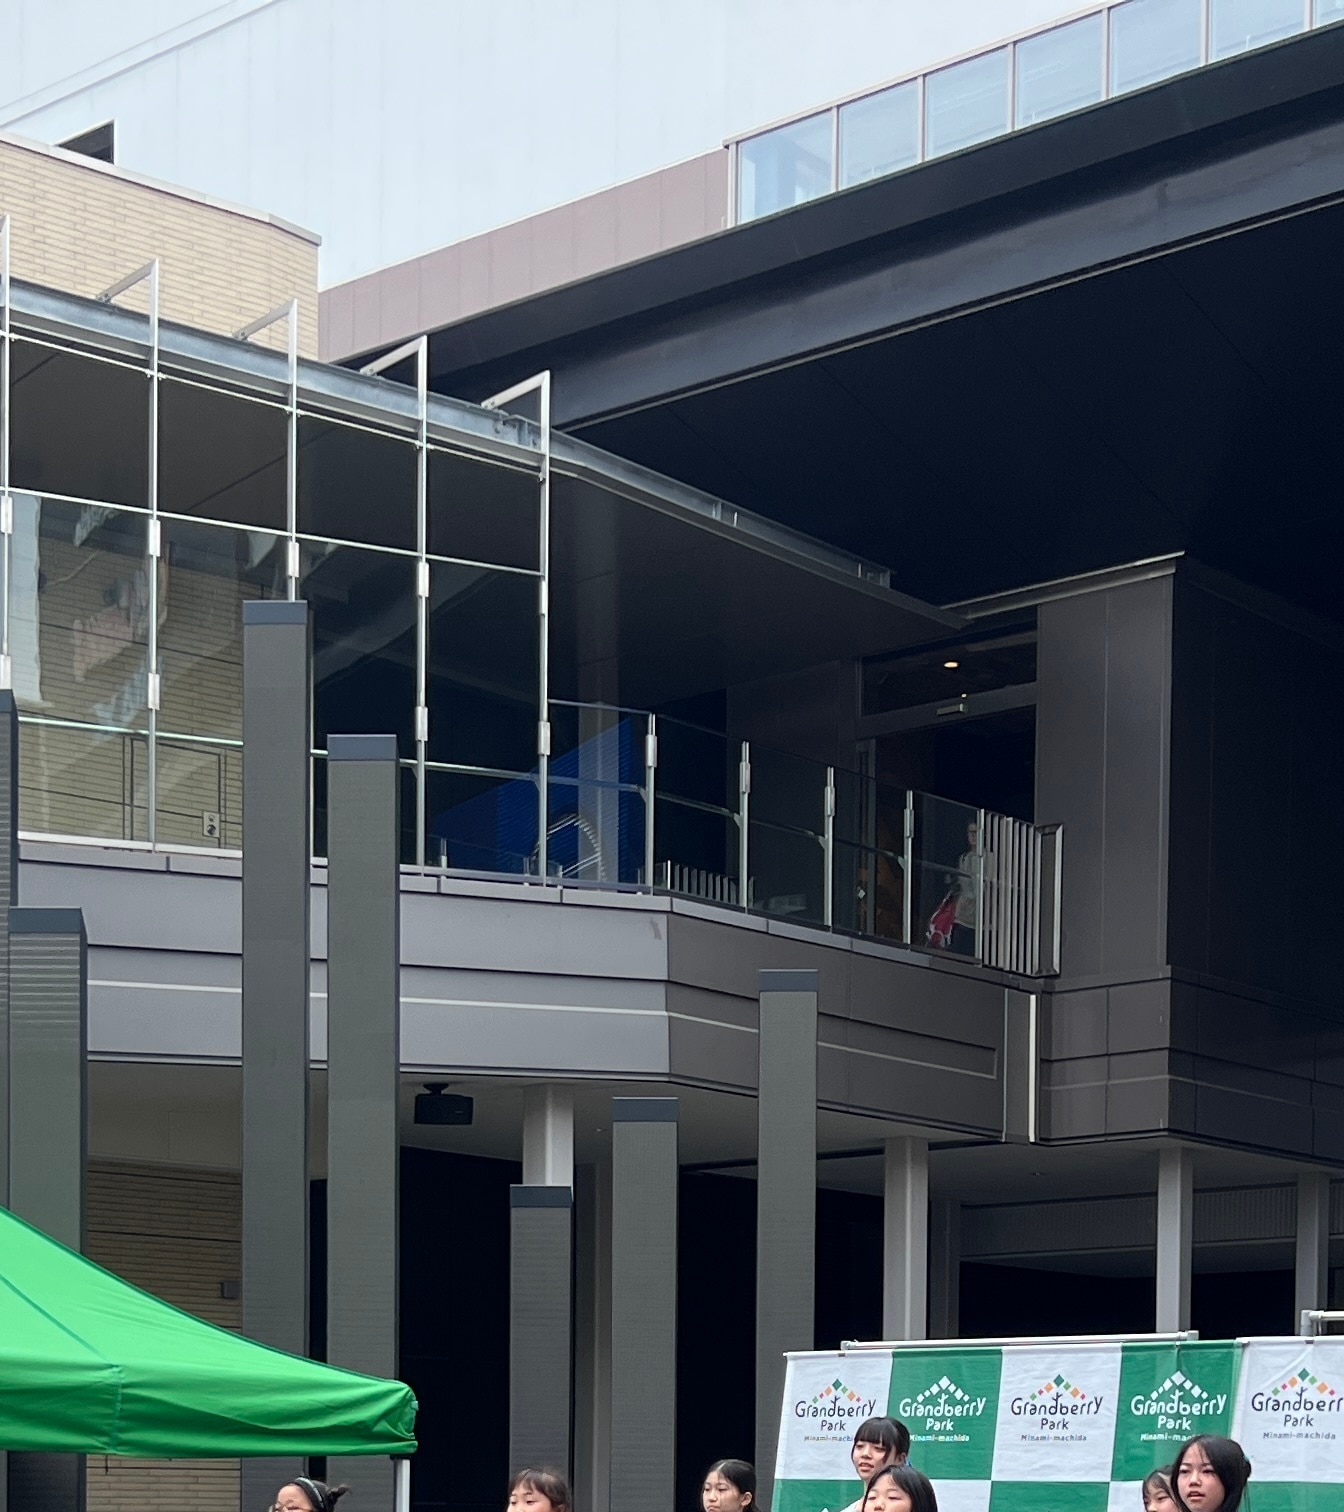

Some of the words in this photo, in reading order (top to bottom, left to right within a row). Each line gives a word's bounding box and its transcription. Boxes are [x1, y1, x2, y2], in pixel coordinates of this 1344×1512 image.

[795, 1395, 876, 1419] Grandberry
[899, 1394, 987, 1418] Grandberry
[1010, 1392, 1103, 1416] Grandberry
[1130, 1389, 1228, 1417] Grandberry
[820, 1420, 846, 1432] Park
[925, 1417, 954, 1431] Park
[1040, 1418, 1070, 1431] Park
[1157, 1415, 1192, 1431] Park
[1283, 1414, 1314, 1427] Park
[804, 1434, 856, 1442] Minami-machi
[1021, 1434, 1087, 1442] Minami-machida
[1140, 1433, 1193, 1442] Minami-mac
[1263, 1431, 1336, 1440] Minami-machida
